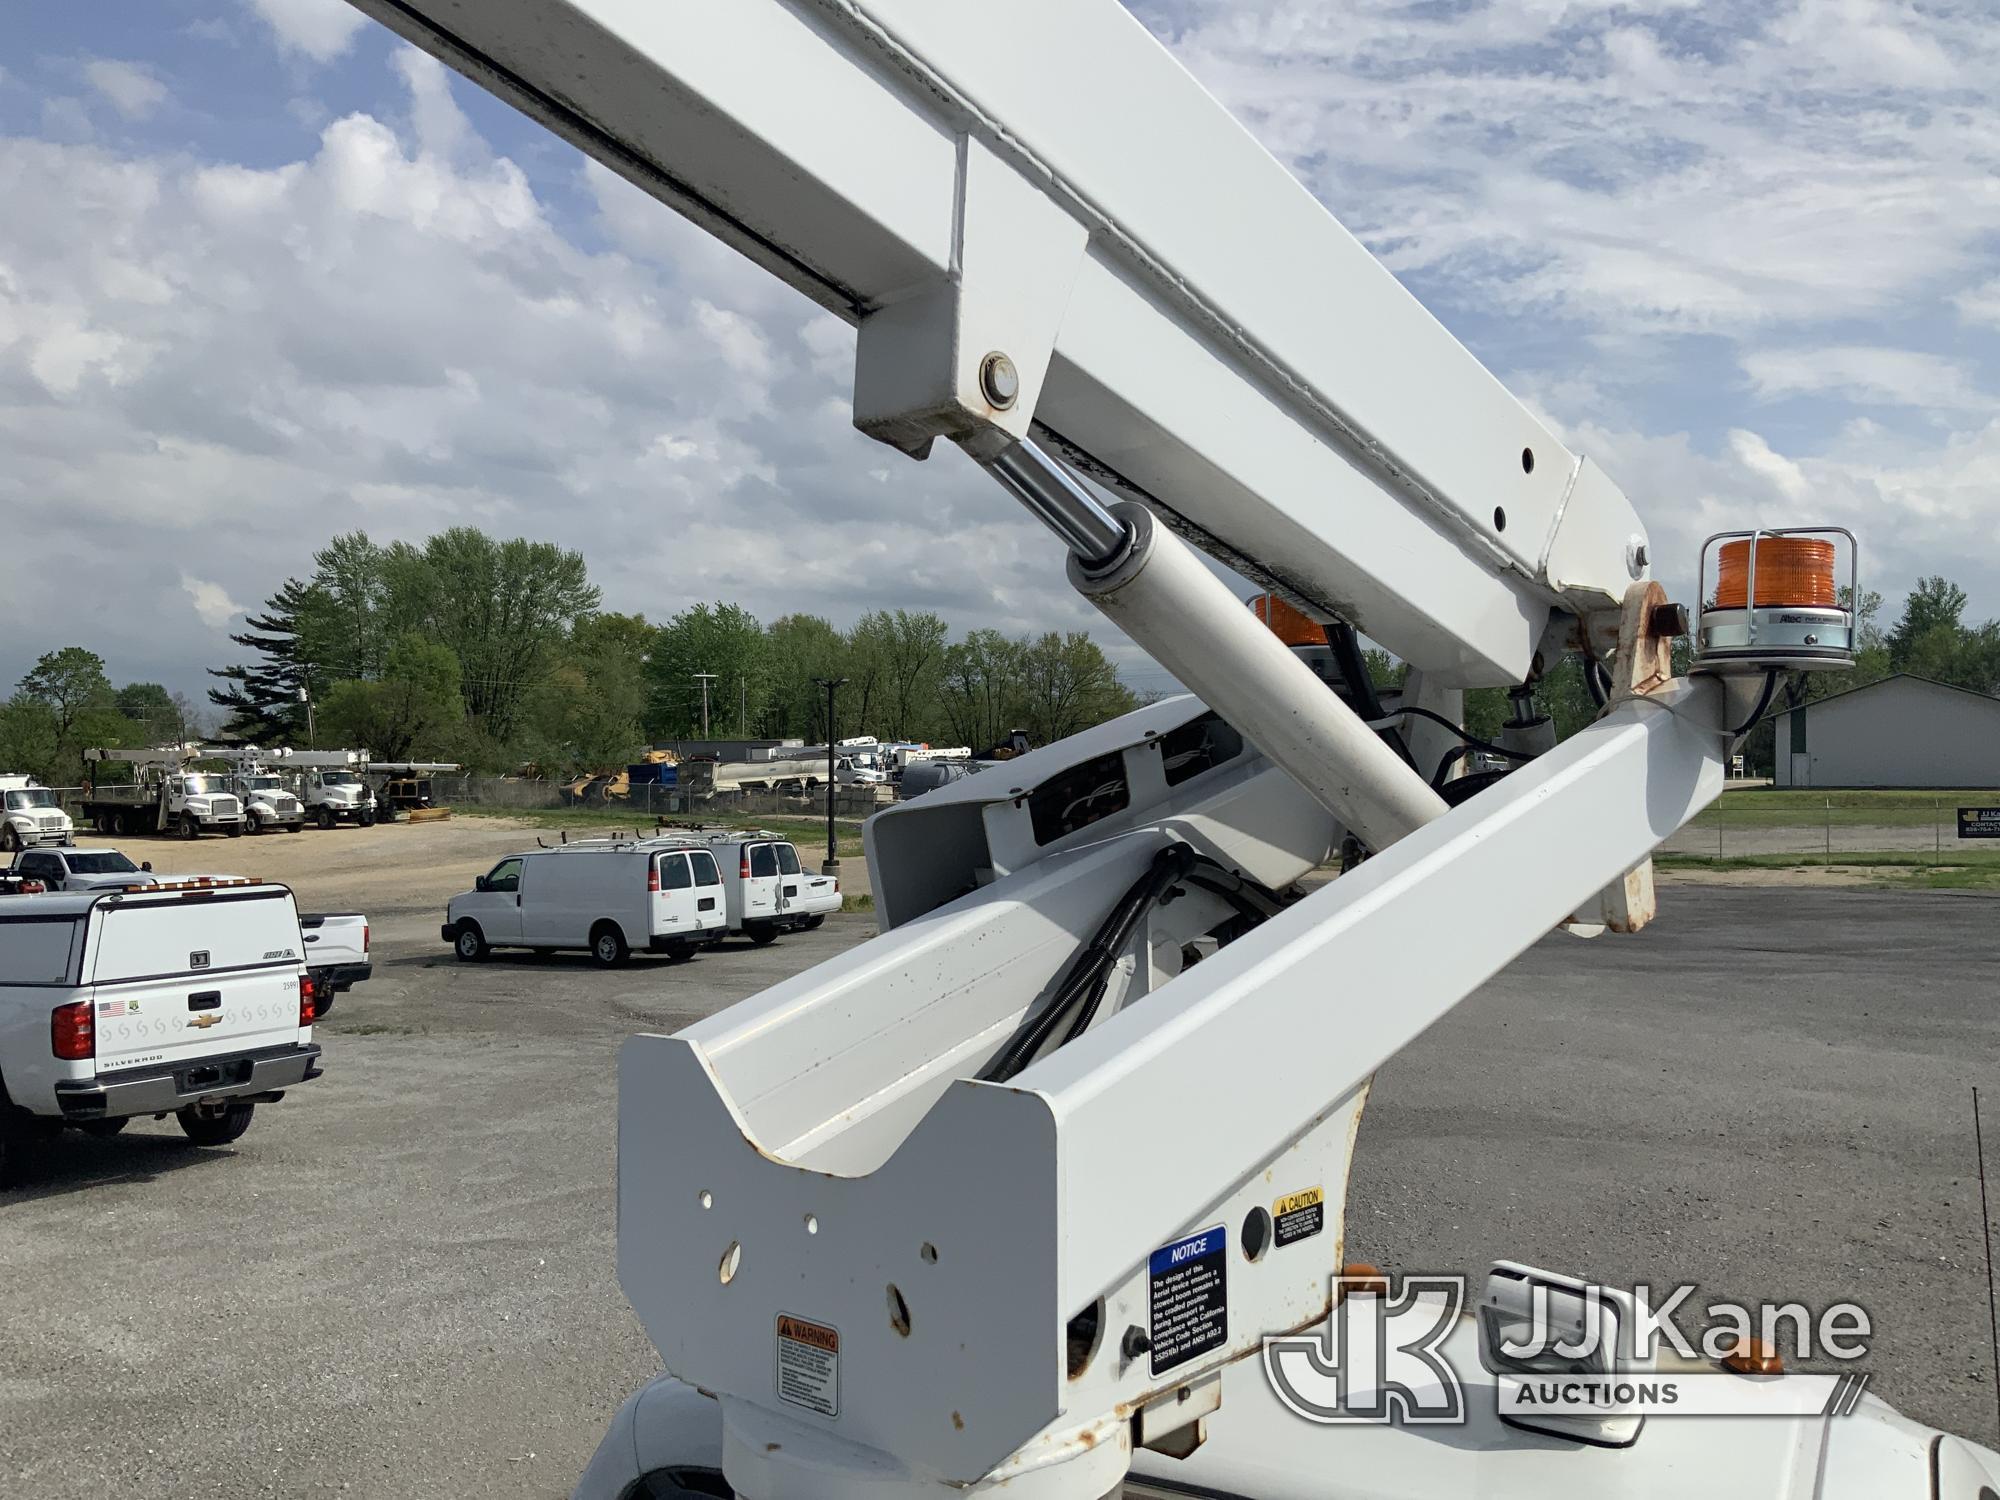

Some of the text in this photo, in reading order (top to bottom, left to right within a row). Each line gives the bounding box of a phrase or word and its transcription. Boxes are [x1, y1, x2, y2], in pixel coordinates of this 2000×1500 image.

[1780, 613, 1802, 624] Altec
[103, 1055, 163, 1068] SILVERADO
[1288, 1189, 1319, 1211] CAUTION
[1171, 1237, 1208, 1263] NOTICE
[1153, 1264, 1203, 1289] The design of this
[1153, 1287, 1170, 1299] Aerial
[1171, 1281, 1189, 1292] device
[1190, 1271, 1212, 1284] ensures
[1153, 1295, 1174, 1310] stowed
[1175, 1290, 1192, 1301] boom
[1192, 1281, 1214, 1294] remains
[1153, 1293, 1209, 1321] the cradled position
[1153, 1304, 1205, 1331] during transport in
[1153, 1305, 1225, 1341] compliance with California
[793, 1323, 836, 1349] WARNING
[1154, 1321, 1213, 1351] Vehicle Code Section
[1180, 1340, 1191, 1351] and
[1192, 1333, 1206, 1345] ANSI
